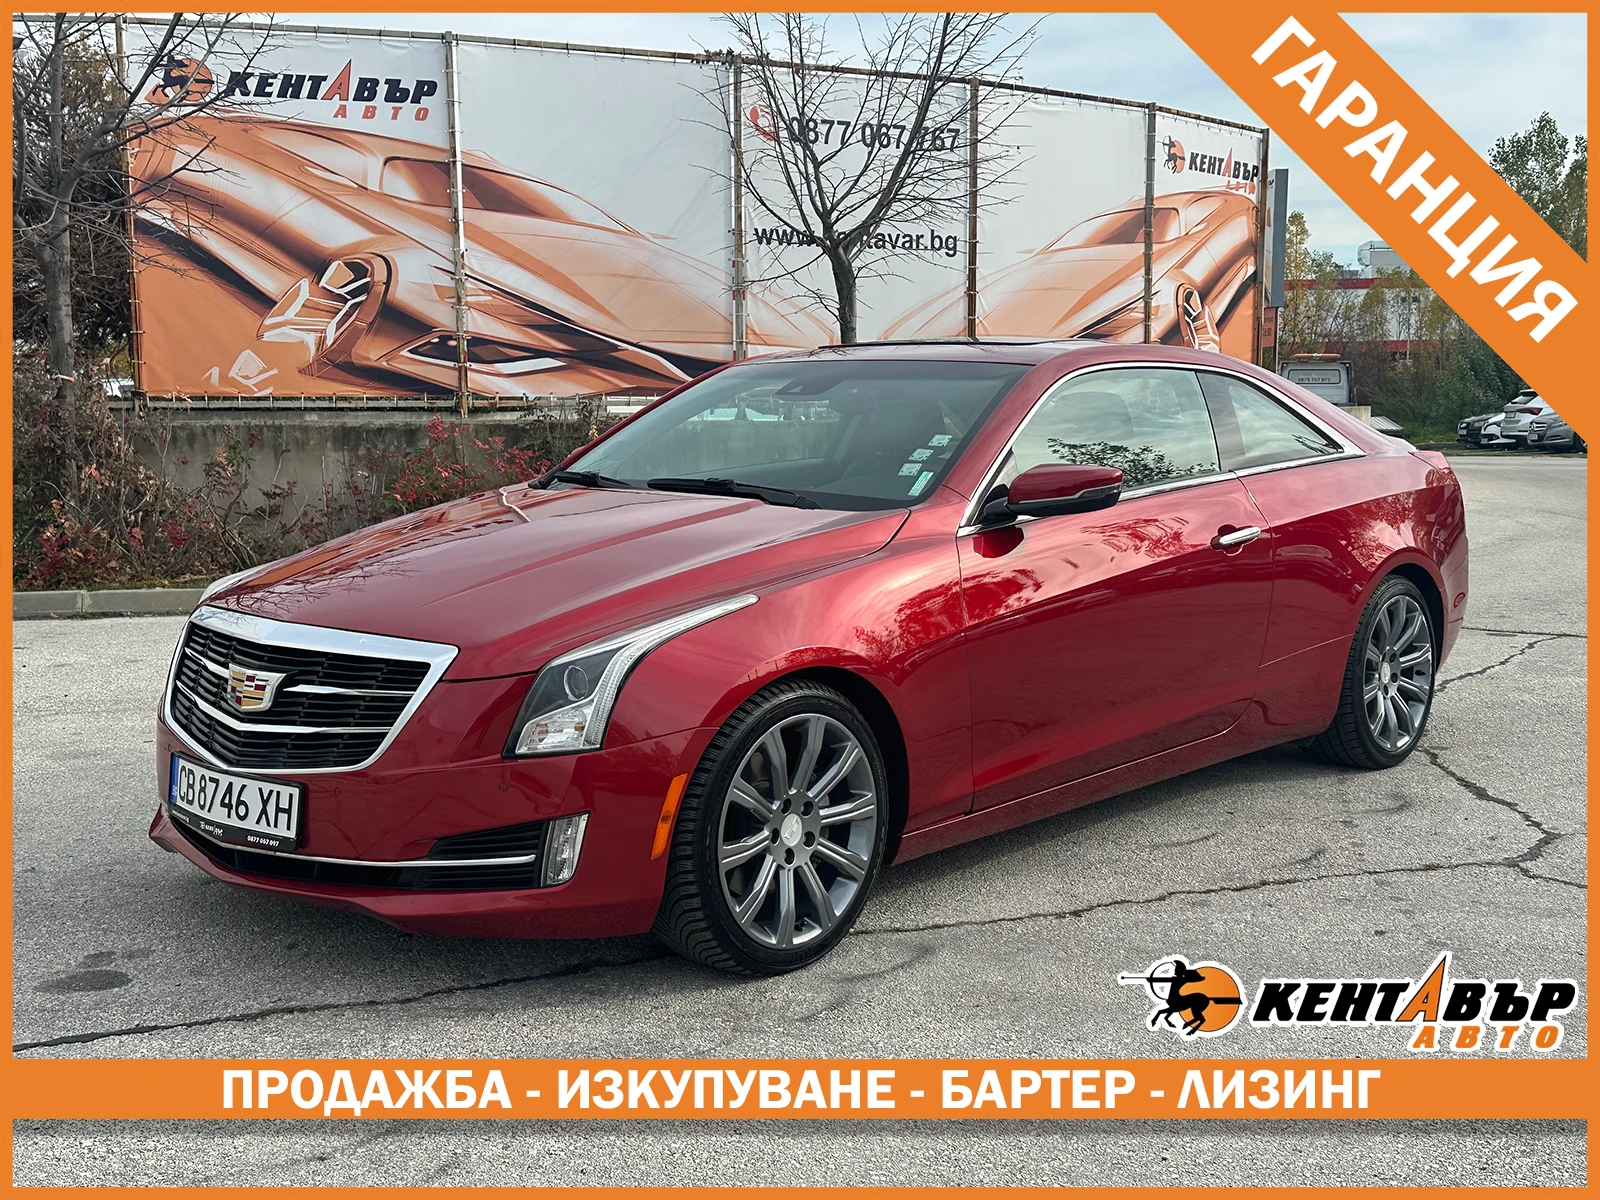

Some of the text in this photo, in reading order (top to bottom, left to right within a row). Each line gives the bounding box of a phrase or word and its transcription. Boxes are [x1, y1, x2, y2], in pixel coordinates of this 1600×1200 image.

[222, 58, 438, 104] КЕНТАВЪР
[333, 104, 430, 121] АВТО
[860, 121, 907, 150] 067
[1188, 147, 1260, 183] КЕНТАВЪР
